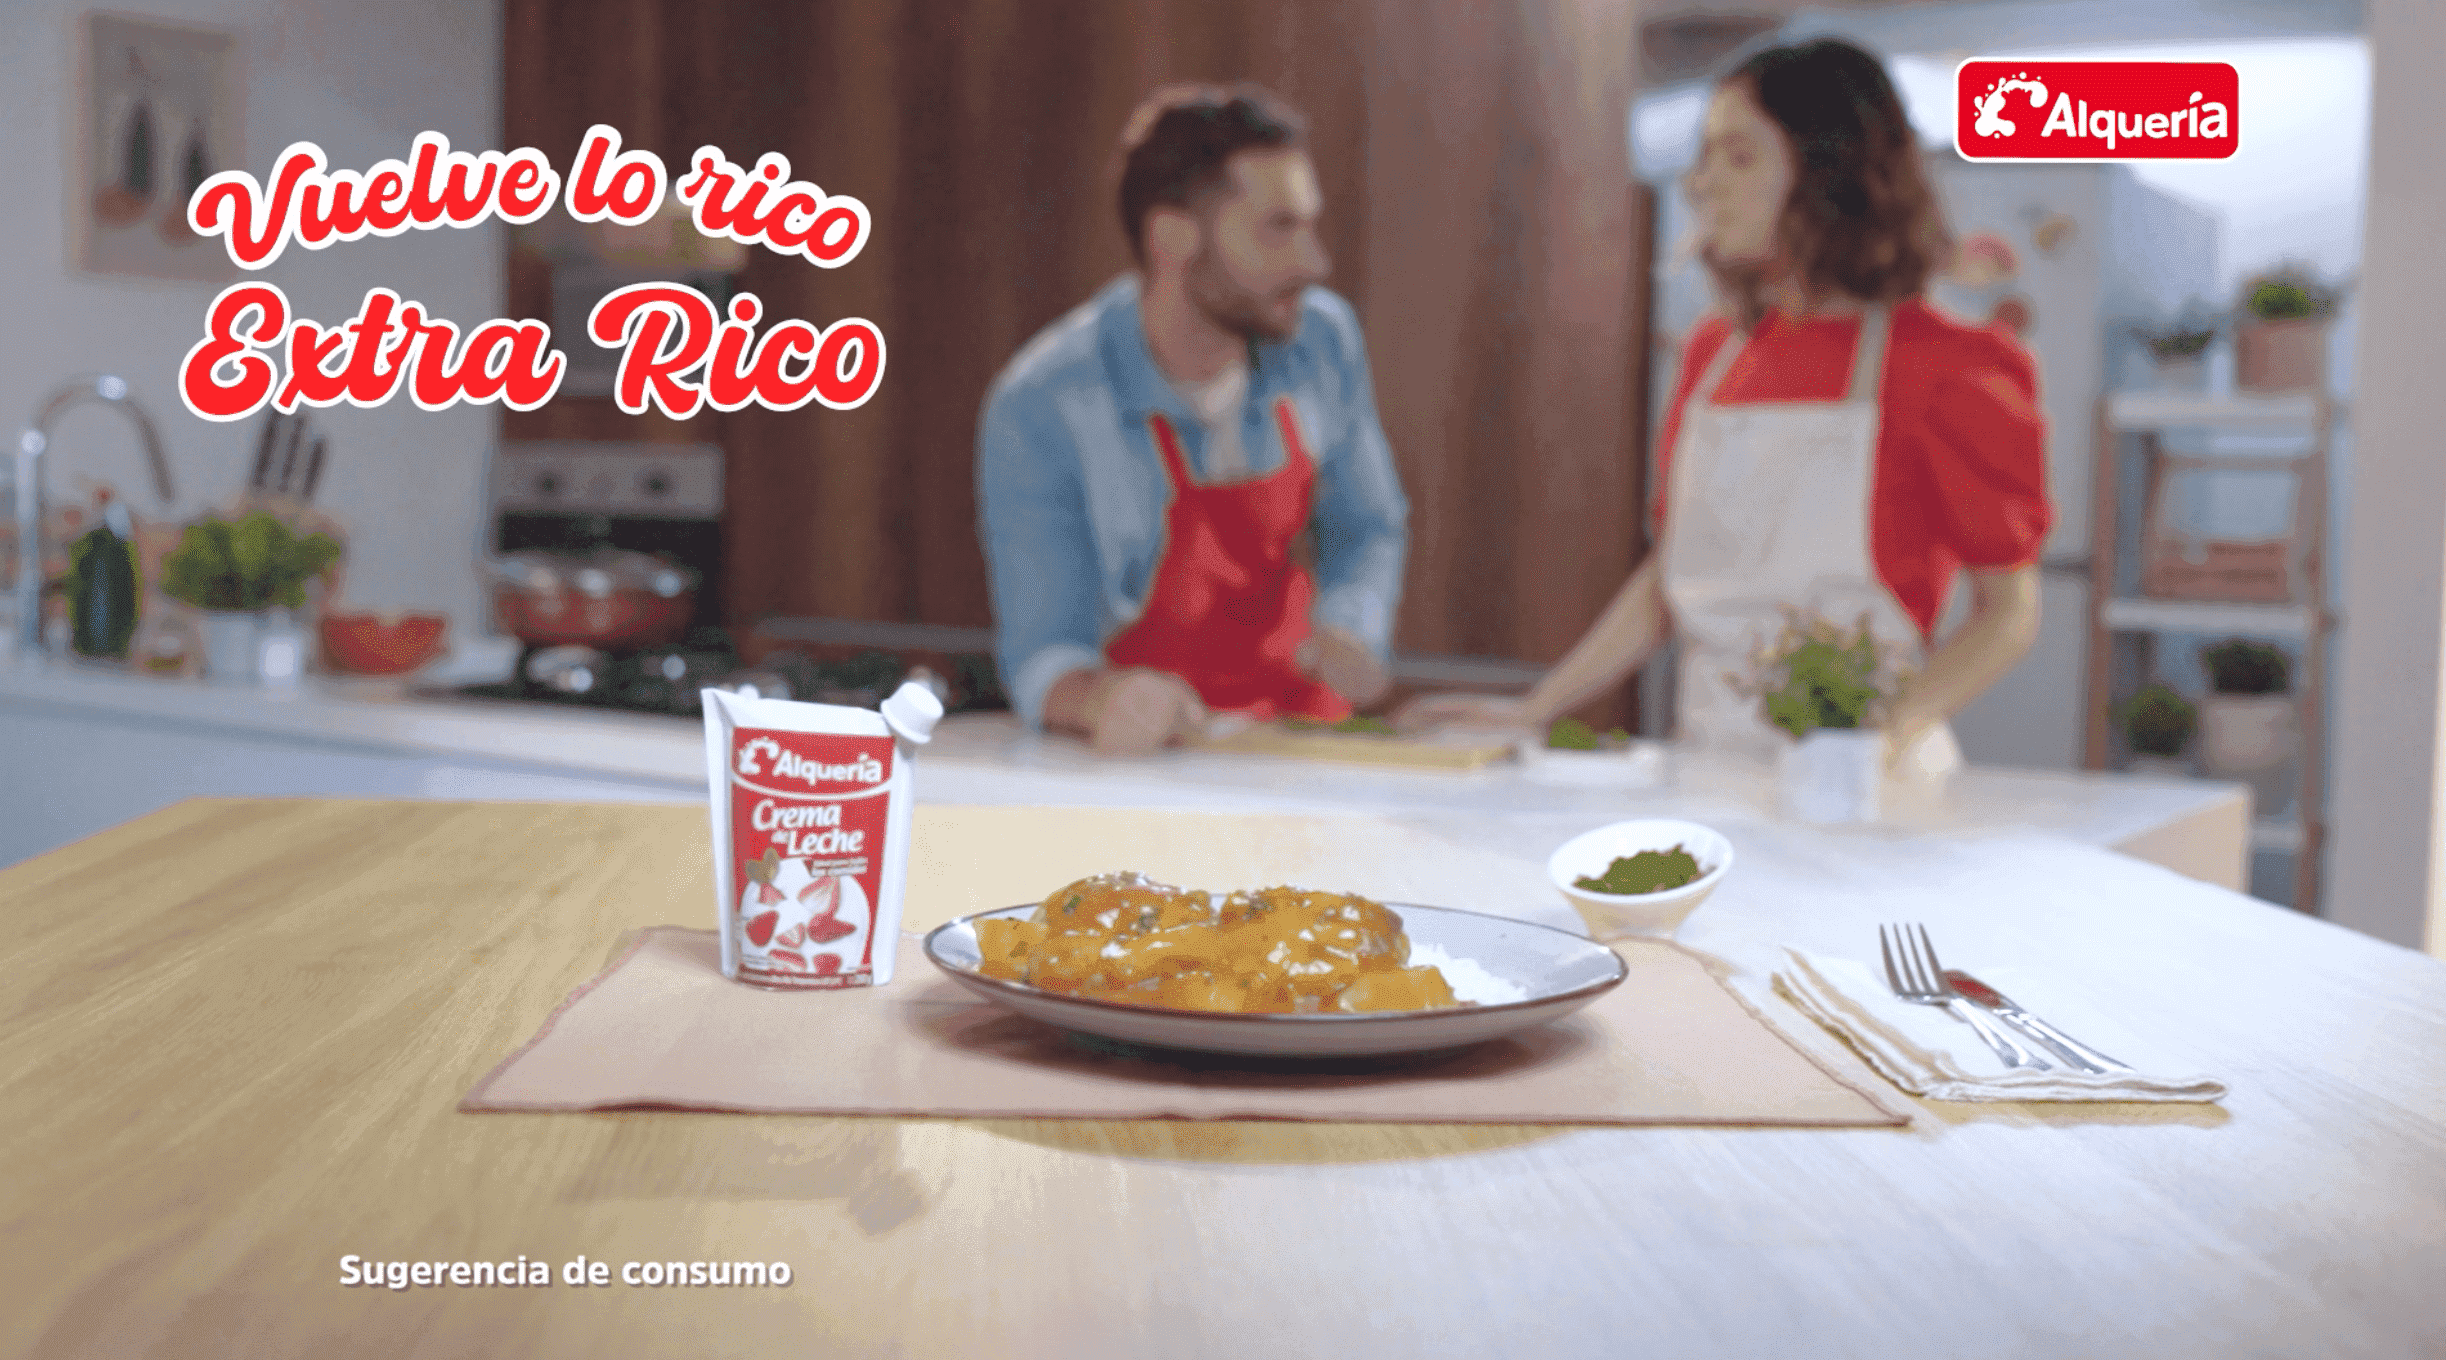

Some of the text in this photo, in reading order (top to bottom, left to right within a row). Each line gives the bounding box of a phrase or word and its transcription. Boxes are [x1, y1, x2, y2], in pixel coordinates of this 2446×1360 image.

[772, 750, 882, 785] Alquería
[753, 799, 841, 830] Crema
[786, 828, 864, 855] Leche
